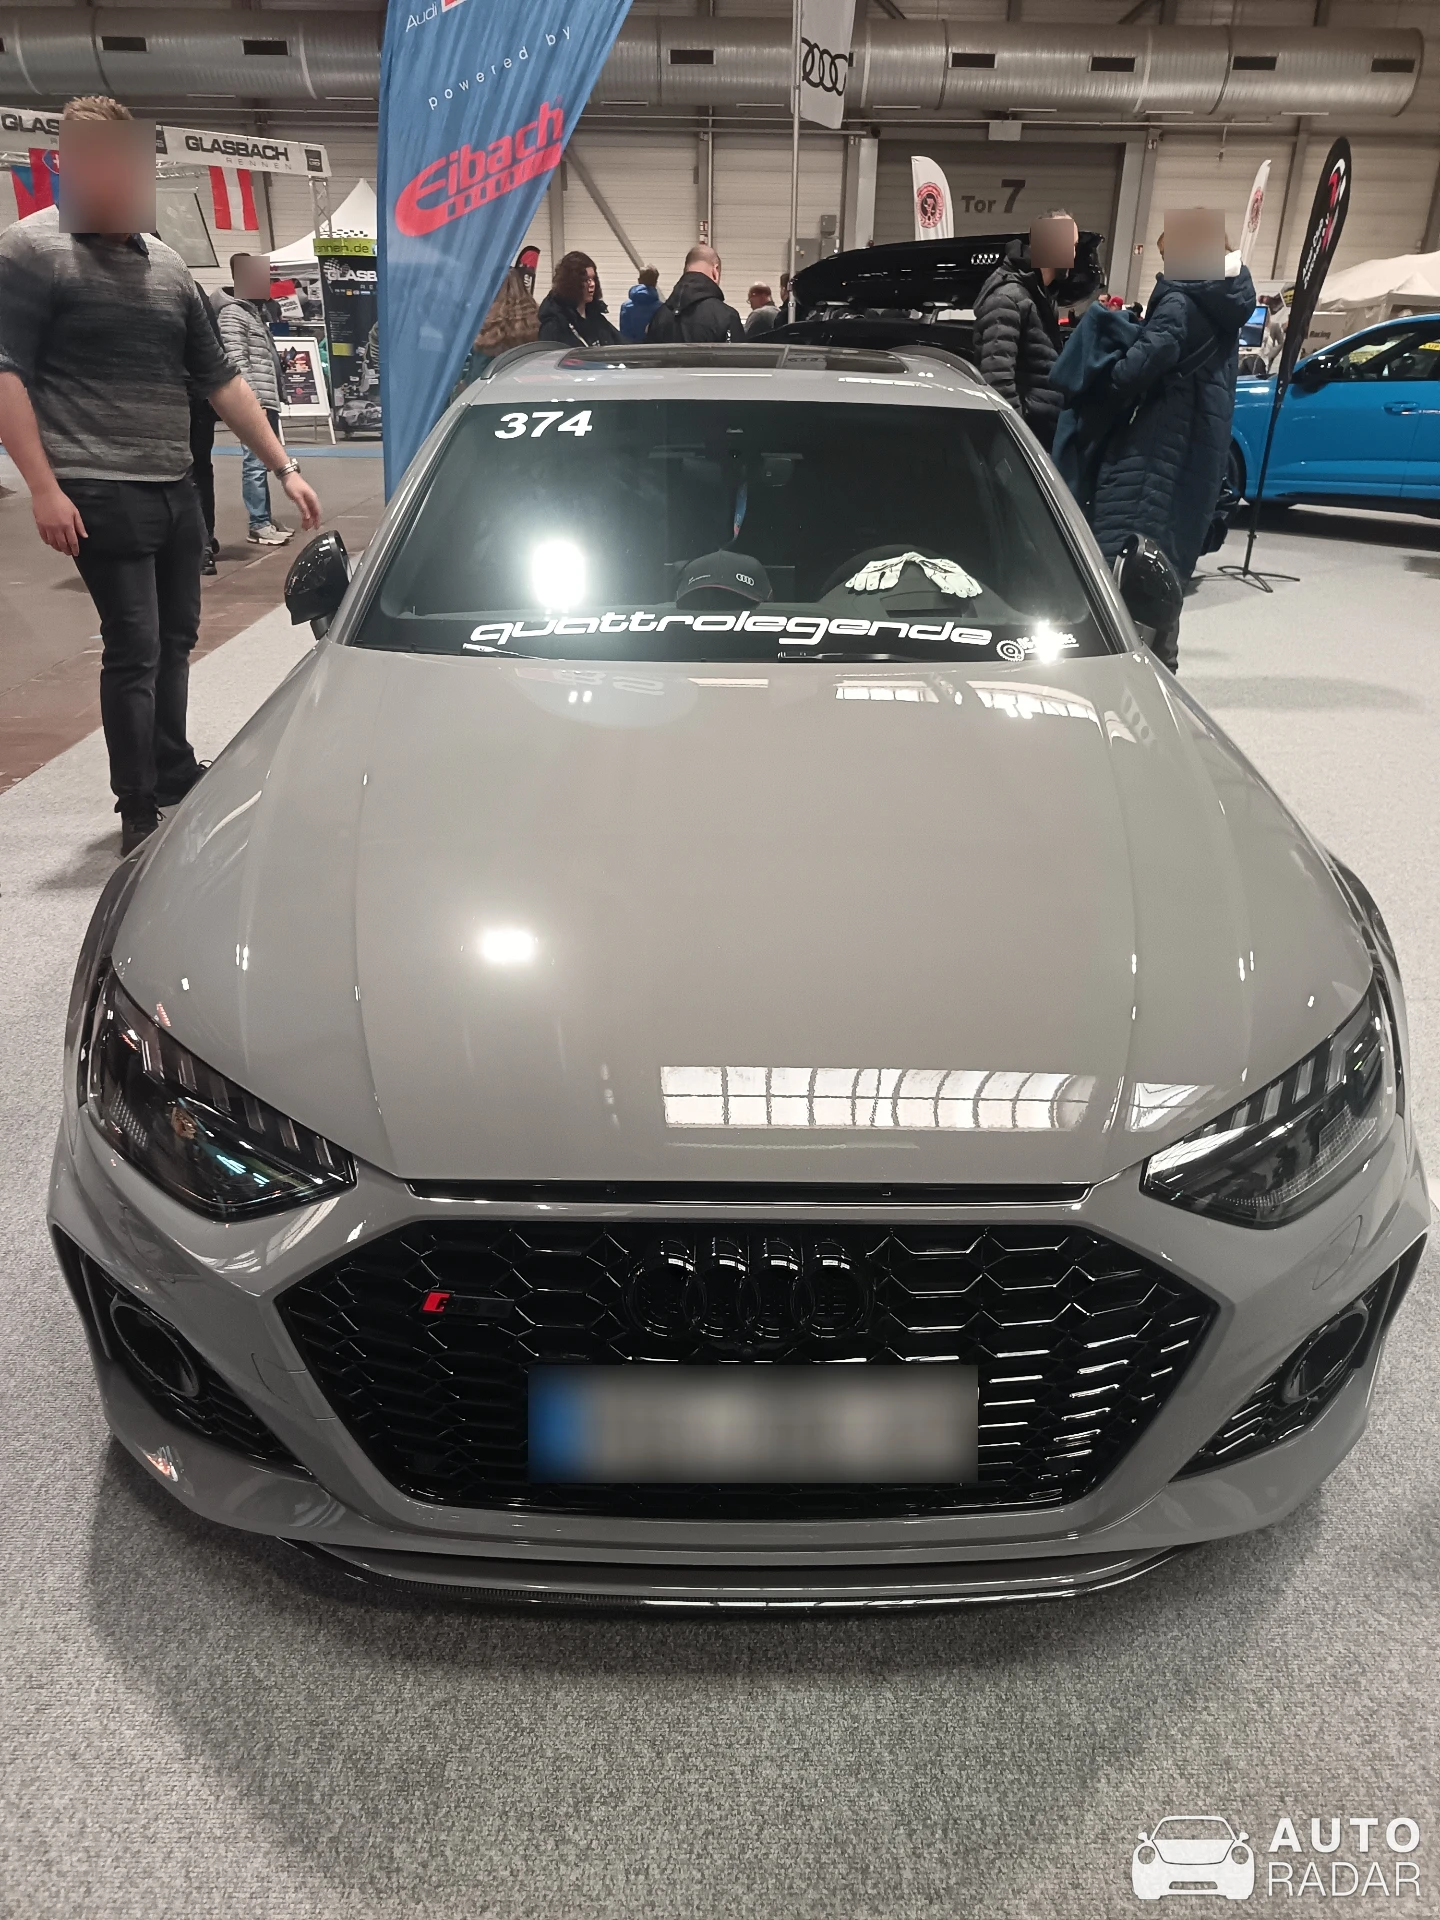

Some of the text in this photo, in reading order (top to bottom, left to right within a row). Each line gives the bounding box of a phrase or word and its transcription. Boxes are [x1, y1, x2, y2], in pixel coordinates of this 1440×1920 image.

[405, 2, 438, 33] Audi
[428, 26, 572, 110] powered by
[1, 114, 59, 136] GLAS
[185, 135, 290, 162] GLASBACH
[226, 157, 292, 170] RENNEN
[395, 101, 564, 237] Eibach
[961, 195, 996, 213] Tor
[1001, 179, 1026, 213] 7
[315, 244, 369, 254] ennen.de
[327, 270, 377, 282] GLASB
[1309, 330, 1332, 340] Racing
[494, 410, 593, 439] 374
[470, 610, 993, 646] quattrolegende
